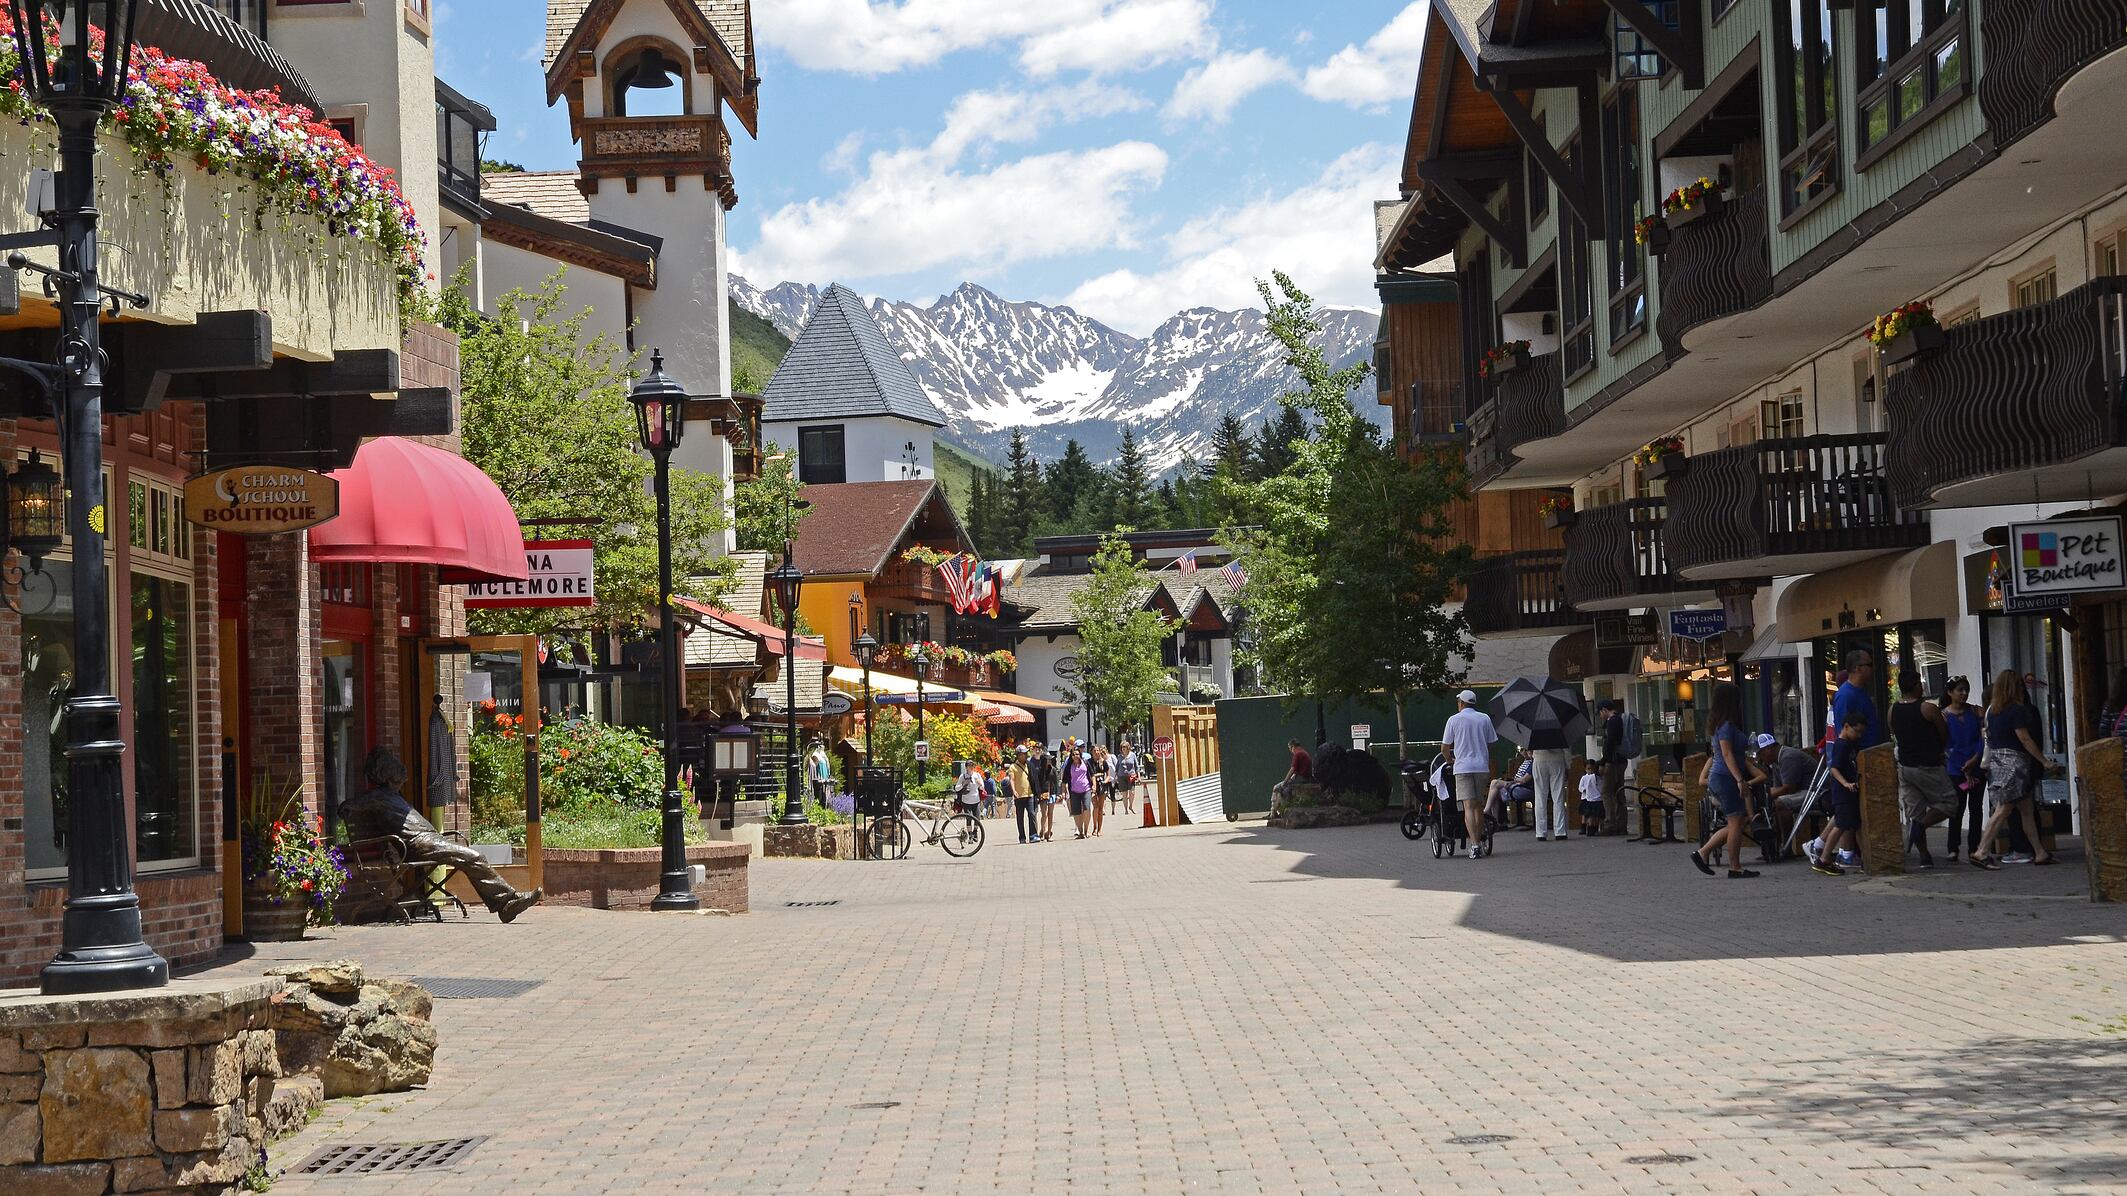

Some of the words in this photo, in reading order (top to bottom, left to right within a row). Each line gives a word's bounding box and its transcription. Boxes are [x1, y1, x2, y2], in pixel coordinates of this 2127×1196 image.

[242, 474, 304, 487] CHARM
[243, 490, 310, 504] SCHOOL
[203, 506, 317, 523] BOUTIQUE
[2060, 532, 2110, 558] Pet
[2023, 558, 2116, 586] Boutique
[468, 577, 587, 595] MCLEMORE
[2010, 595, 2069, 610] Jewelers
[1626, 616, 1642, 625] Vail
[1673, 612, 1724, 624] Fantasia
[1627, 625, 1646, 633] Fine
[1687, 624, 1715, 634] Furs
[1627, 634, 1655, 643] Wines
[1153, 742, 1173, 752] STOP
